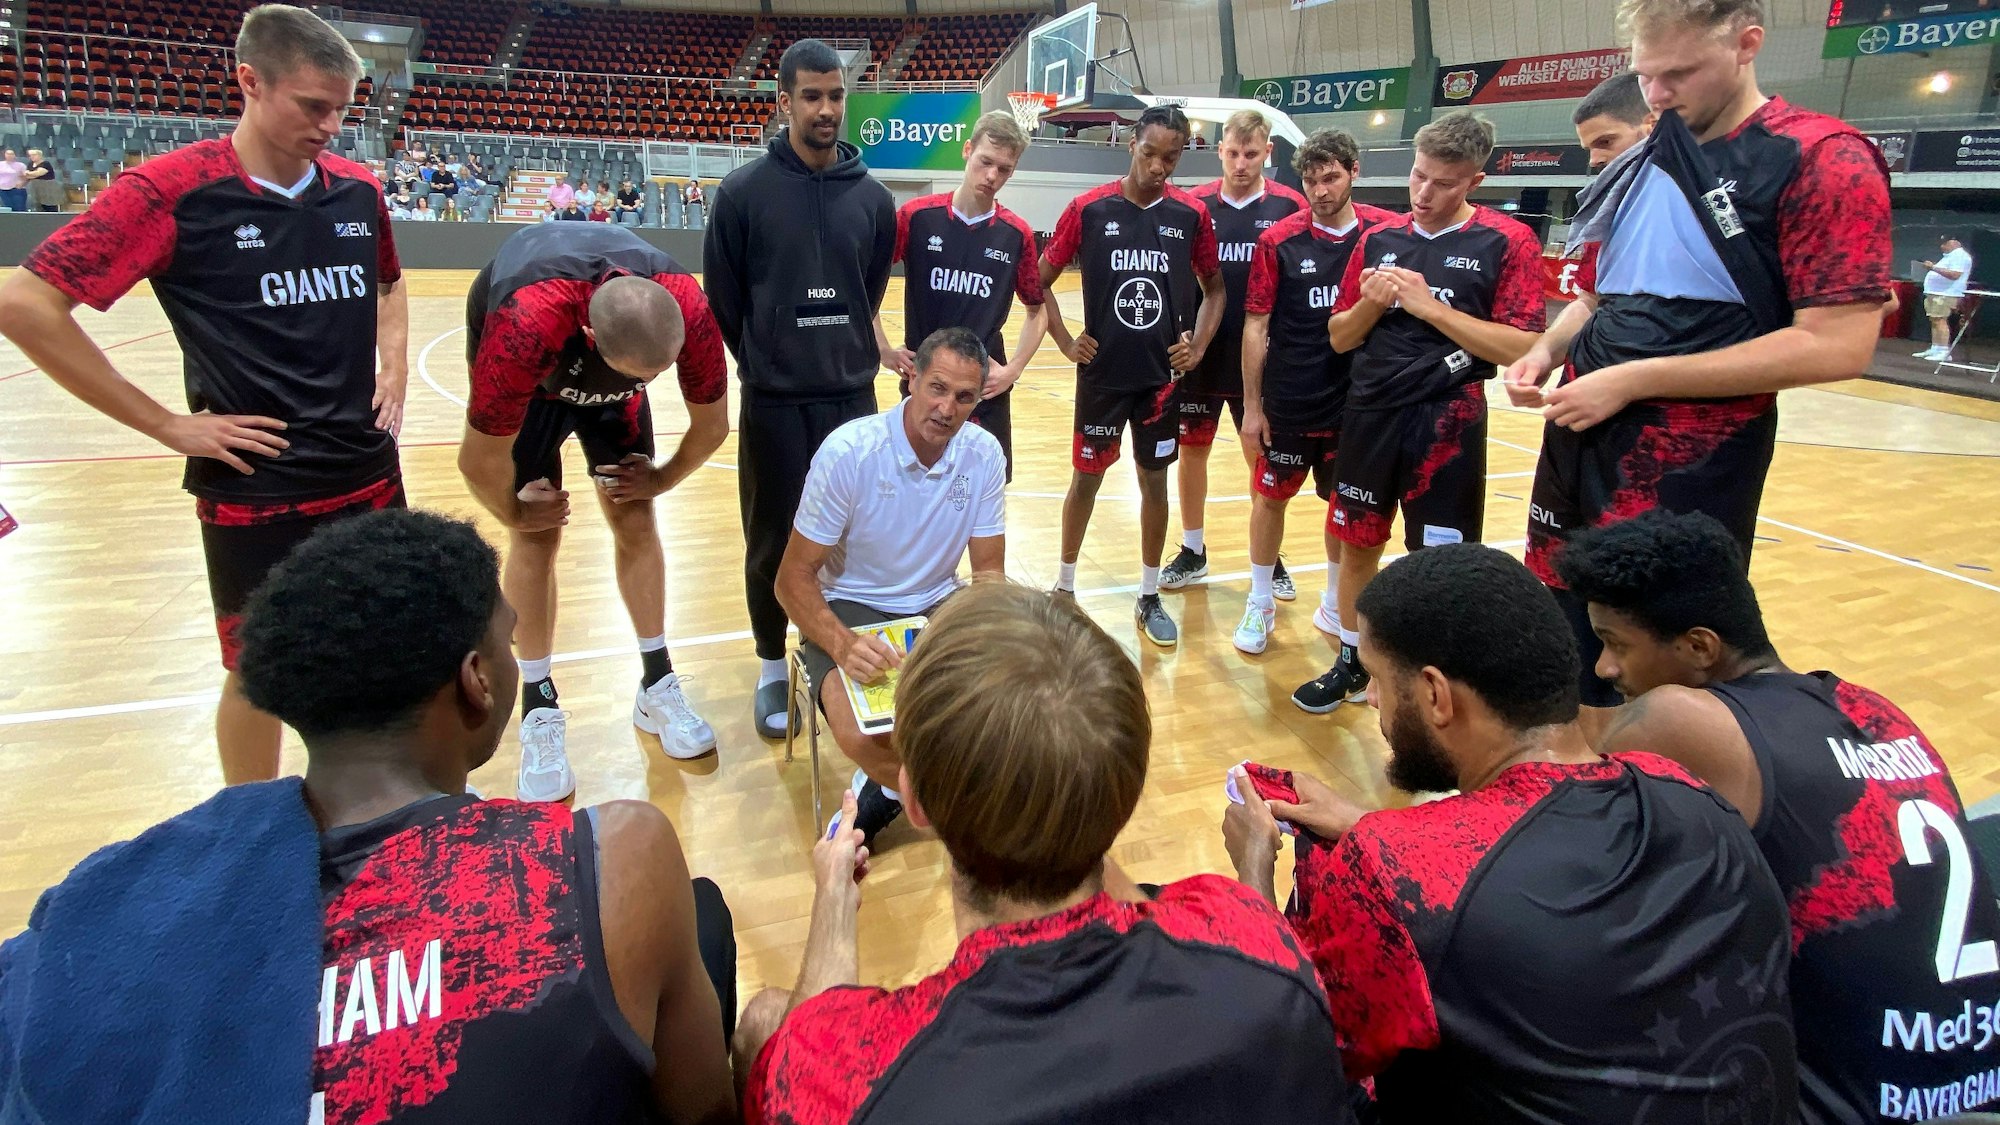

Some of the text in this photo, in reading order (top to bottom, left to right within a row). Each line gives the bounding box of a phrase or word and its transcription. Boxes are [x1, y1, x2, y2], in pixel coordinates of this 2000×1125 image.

[1894, 18, 2000, 47] Bayer
[1519, 61, 1559, 74] ALLES
[1560, 56, 1598, 71] RUND
[1499, 69, 1566, 87] WERKSELF
[1288, 78, 1395, 109] Bayer
[888, 119, 966, 146] Bayer
[349, 222, 372, 237] EVL
[1167, 227, 1184, 240] EVL
[993, 250, 1011, 264] EVL
[1111, 249, 1168, 273] GIANTS
[1217, 242, 1256, 262] IANT
[1456, 257, 1481, 271] EVL
[260, 264, 366, 307] GIANTS
[930, 267, 993, 298] GIANTS
[808, 288, 836, 298] HUGO
[1309, 285, 1339, 308] GIA
[1119, 299, 1159, 309] BAYER
[1187, 403, 1210, 414] EVL
[1095, 426, 1120, 436] EVL
[1280, 453, 1304, 465] EVL
[1350, 486, 1377, 505] EVL
[1531, 502, 1561, 528] EVL
[1898, 799, 1999, 984] 2
[1880, 1082, 1960, 1121] BAYER
